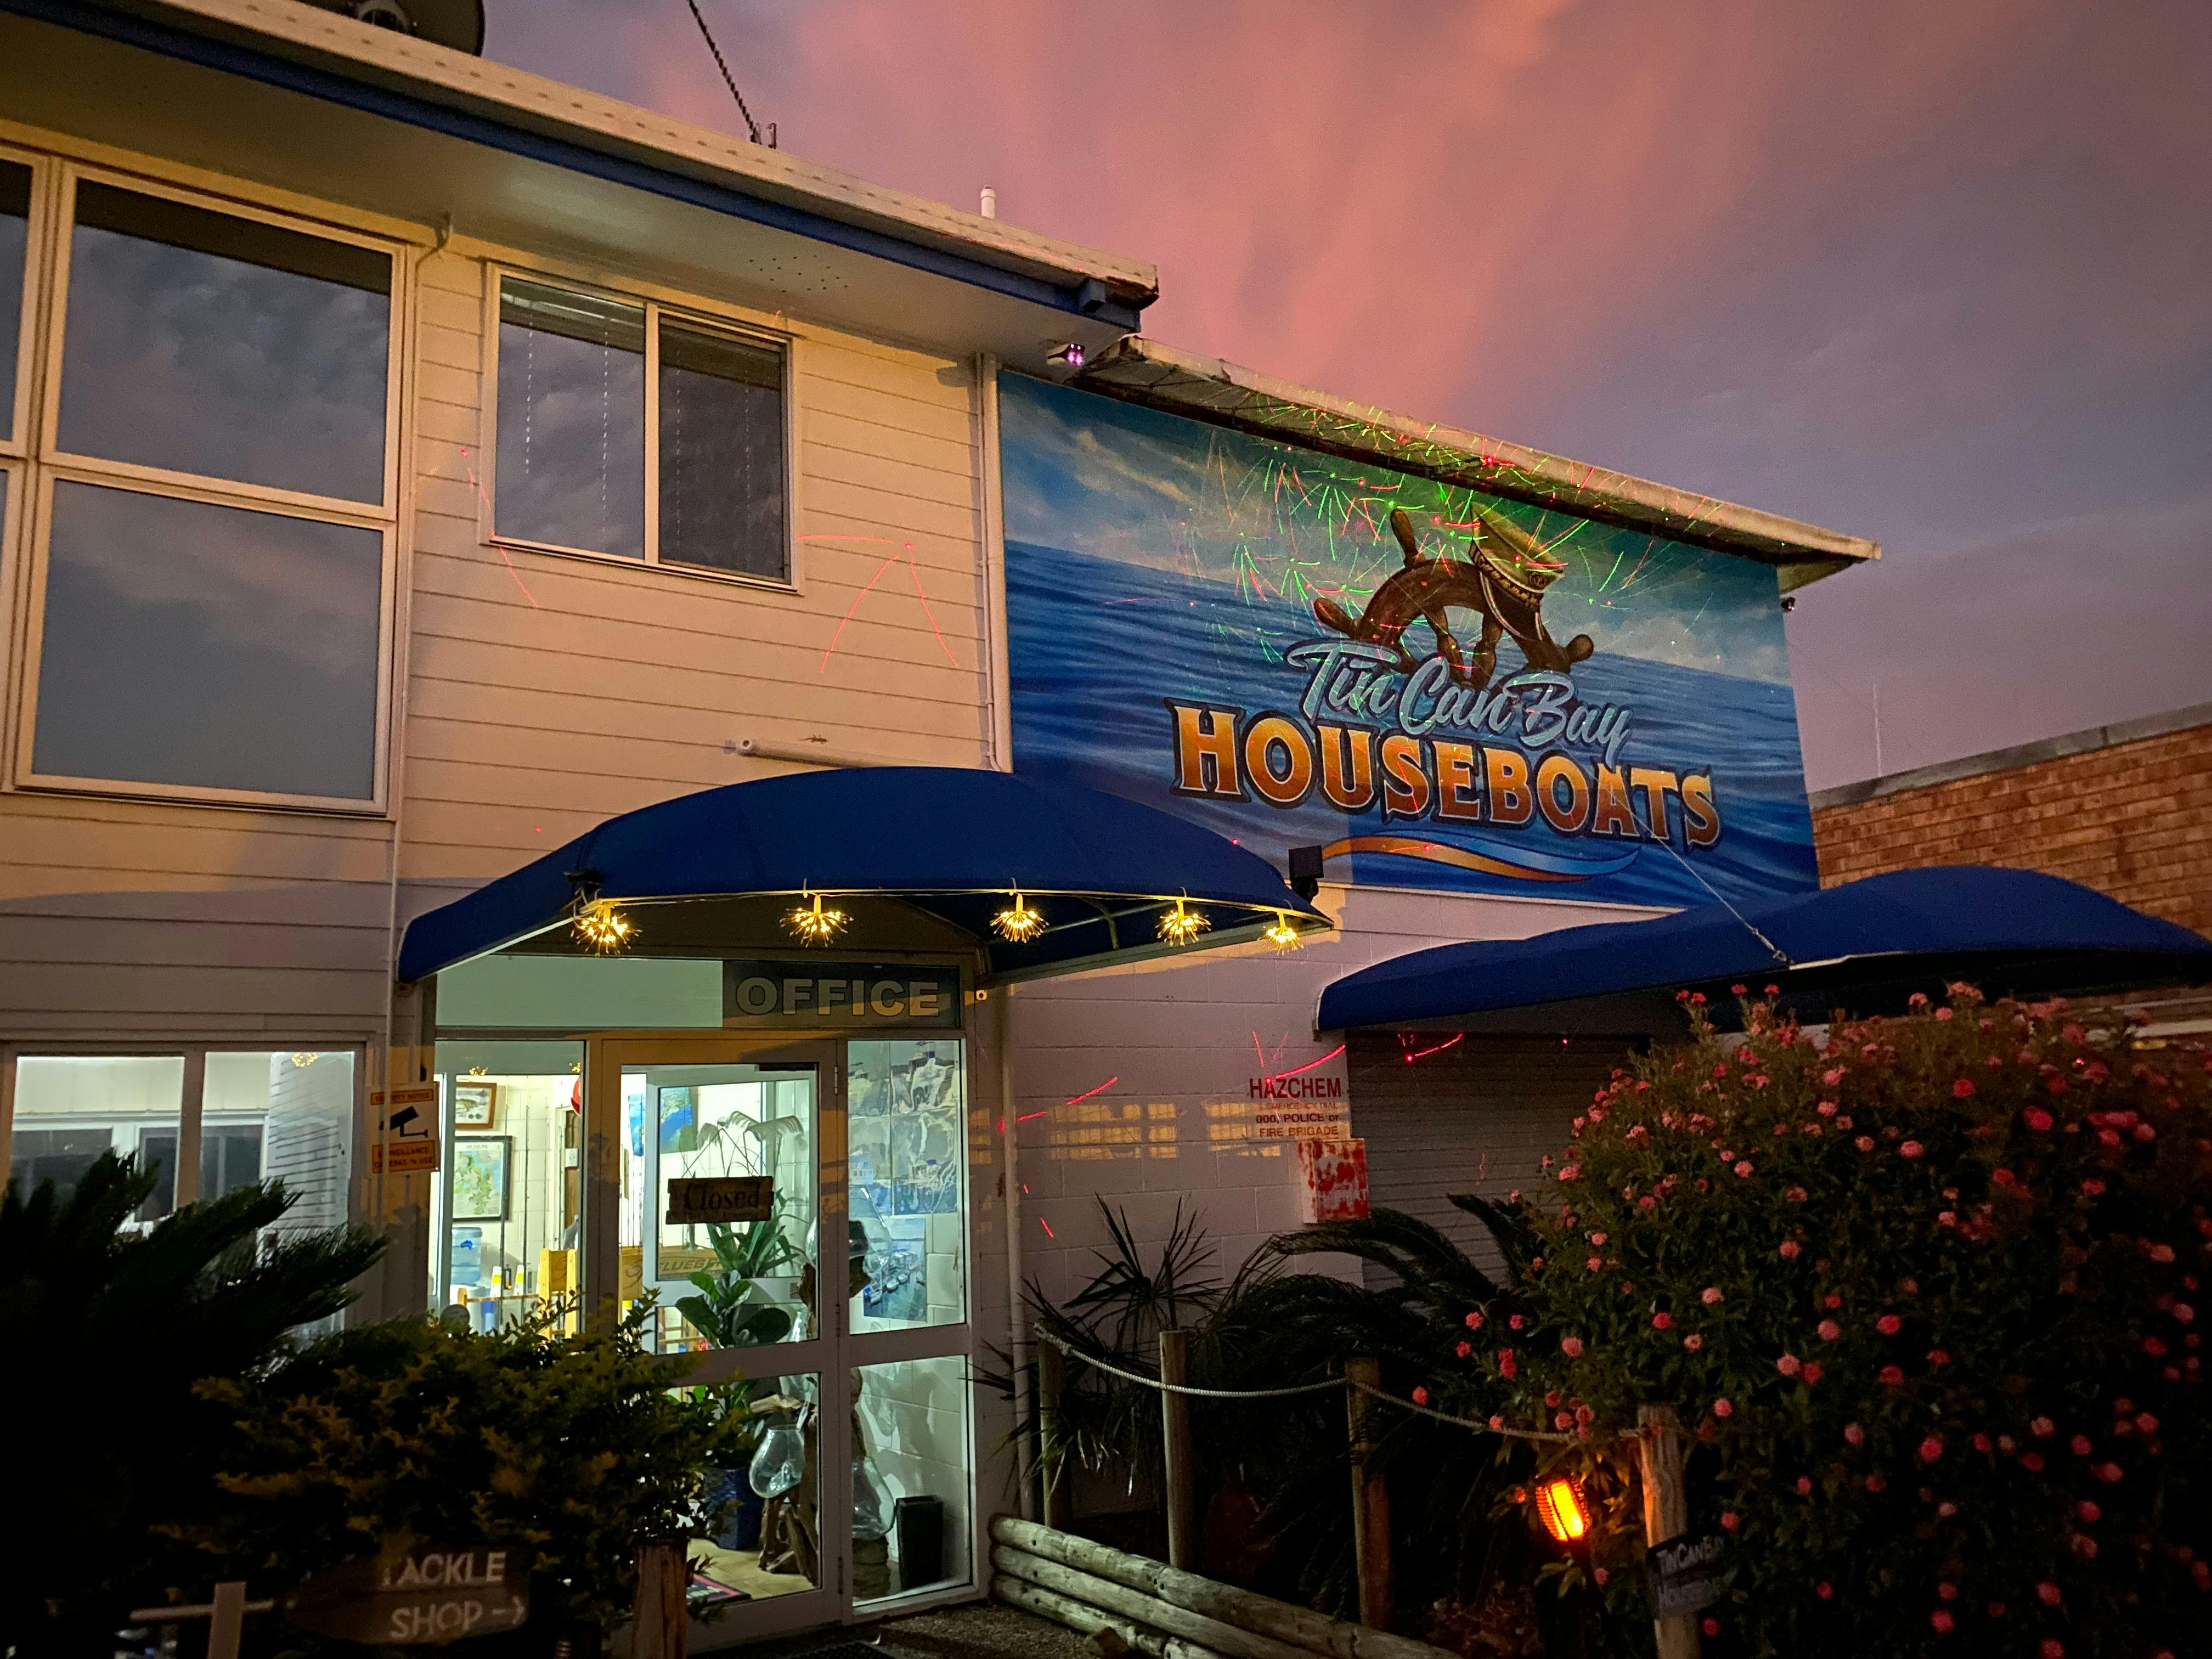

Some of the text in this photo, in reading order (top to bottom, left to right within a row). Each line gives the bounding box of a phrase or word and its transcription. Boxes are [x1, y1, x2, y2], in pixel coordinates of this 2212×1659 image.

[1284, 639, 1633, 770] Tin Can Bay
[1167, 699, 1720, 850] HOUSEBOATS
[735, 976, 940, 1017] OFFICE
[1249, 1077, 1342, 1099] HAZCHEM
[1259, 1126, 1339, 1137] FIRE BRIGADE
[1284, 1113, 1324, 1122] POLICE
[374, 1158, 407, 1167] CAERAS
[684, 1181, 761, 1211] Closed
[390, 1600, 483, 1640] SHOP
